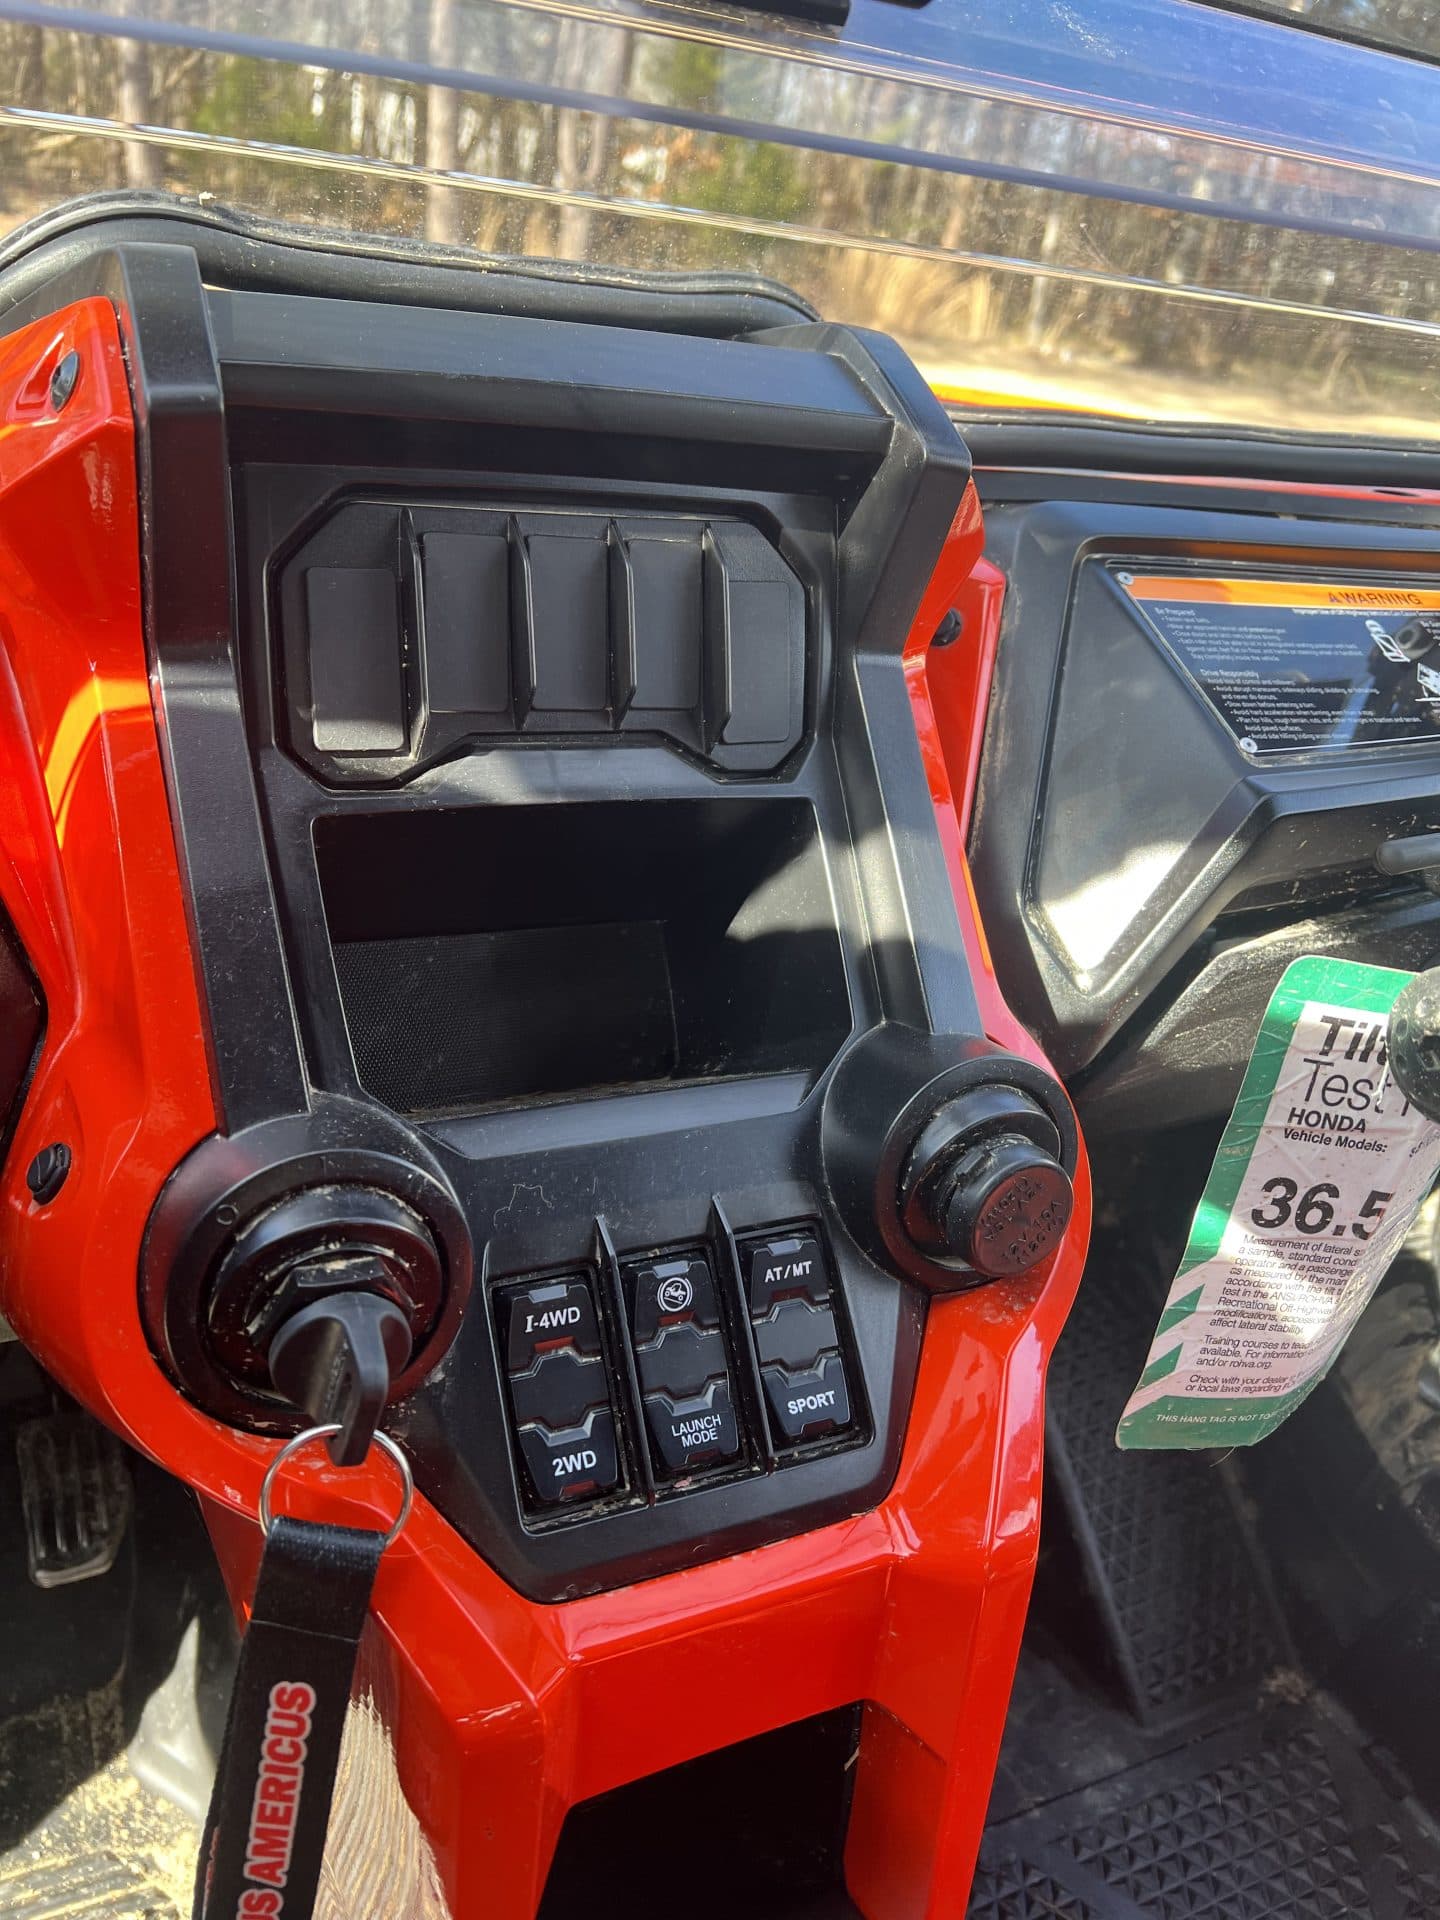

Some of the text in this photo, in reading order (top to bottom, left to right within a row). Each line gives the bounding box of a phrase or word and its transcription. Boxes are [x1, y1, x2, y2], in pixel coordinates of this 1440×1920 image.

[1339, 592, 1423, 606] WARNING
[1287, 1107, 1366, 1133] HONDA
[1284, 1128, 1332, 1146] Vehicle
[1335, 1135, 1388, 1153] Models:
[1251, 1176, 1396, 1240] 36.5
[1244, 1234, 1310, 1252] Measurement
[1311, 1243, 1323, 1253] of
[1323, 1243, 1352, 1256] lateral
[1234, 1257, 1277, 1269] operator
[1279, 1261, 1297, 1271] and
[1238, 1246, 1246, 1254] a
[1247, 1247, 1285, 1260] sample,
[1288, 1252, 1331, 1265] standard
[764, 1261, 812, 1283] AT/MT
[1229, 1267, 1242, 1276] as
[1244, 1268, 1292, 1280] measured
[1294, 1272, 1308, 1282] by
[1308, 1274, 1324, 1284] the
[1222, 1286, 1240, 1297] test
[1241, 1288, 1251, 1298] in
[1253, 1289, 1269, 1299] the
[1225, 1277, 1282, 1291] accordance
[1285, 1283, 1305, 1292] with
[1306, 1284, 1322, 1294] the
[1324, 1286, 1335, 1295] tilt
[1217, 1296, 1278, 1312] Recreational
[525, 1306, 581, 1333] I-4WD
[1210, 1317, 1236, 1328] affect
[1238, 1320, 1267, 1331] lateral
[1213, 1309, 1278, 1323] modifications,
[1205, 1335, 1240, 1348] Training
[1242, 1340, 1279, 1349] courses
[1280, 1341, 1290, 1350] to
[1200, 1346, 1241, 1359] available.
[1245, 1350, 1260, 1359] For
[1196, 1356, 1273, 1370] and/or rohva.org.
[1185, 1384, 1194, 1392] or
[1198, 1383, 1218, 1393] local
[1219, 1384, 1240, 1393] laws
[1241, 1383, 1283, 1395] regarding
[1189, 1374, 1218, 1384] Check
[1221, 1374, 1240, 1384] with
[1241, 1375, 1260, 1387] your
[1262, 1374, 1288, 1384] dealer
[787, 1391, 836, 1415] SPORT
[671, 1414, 722, 1437] LAUNCH
[1156, 1414, 1178, 1423] THIS
[1179, 1415, 1206, 1423] HANG
[1209, 1415, 1227, 1423] TAG
[1228, 1415, 1236, 1424] IS
[1238, 1414, 1257, 1423] NOT
[681, 1428, 718, 1448] MODE
[552, 1450, 597, 1477] 2WD
[243, 1681, 316, 1888] AMERICUS
